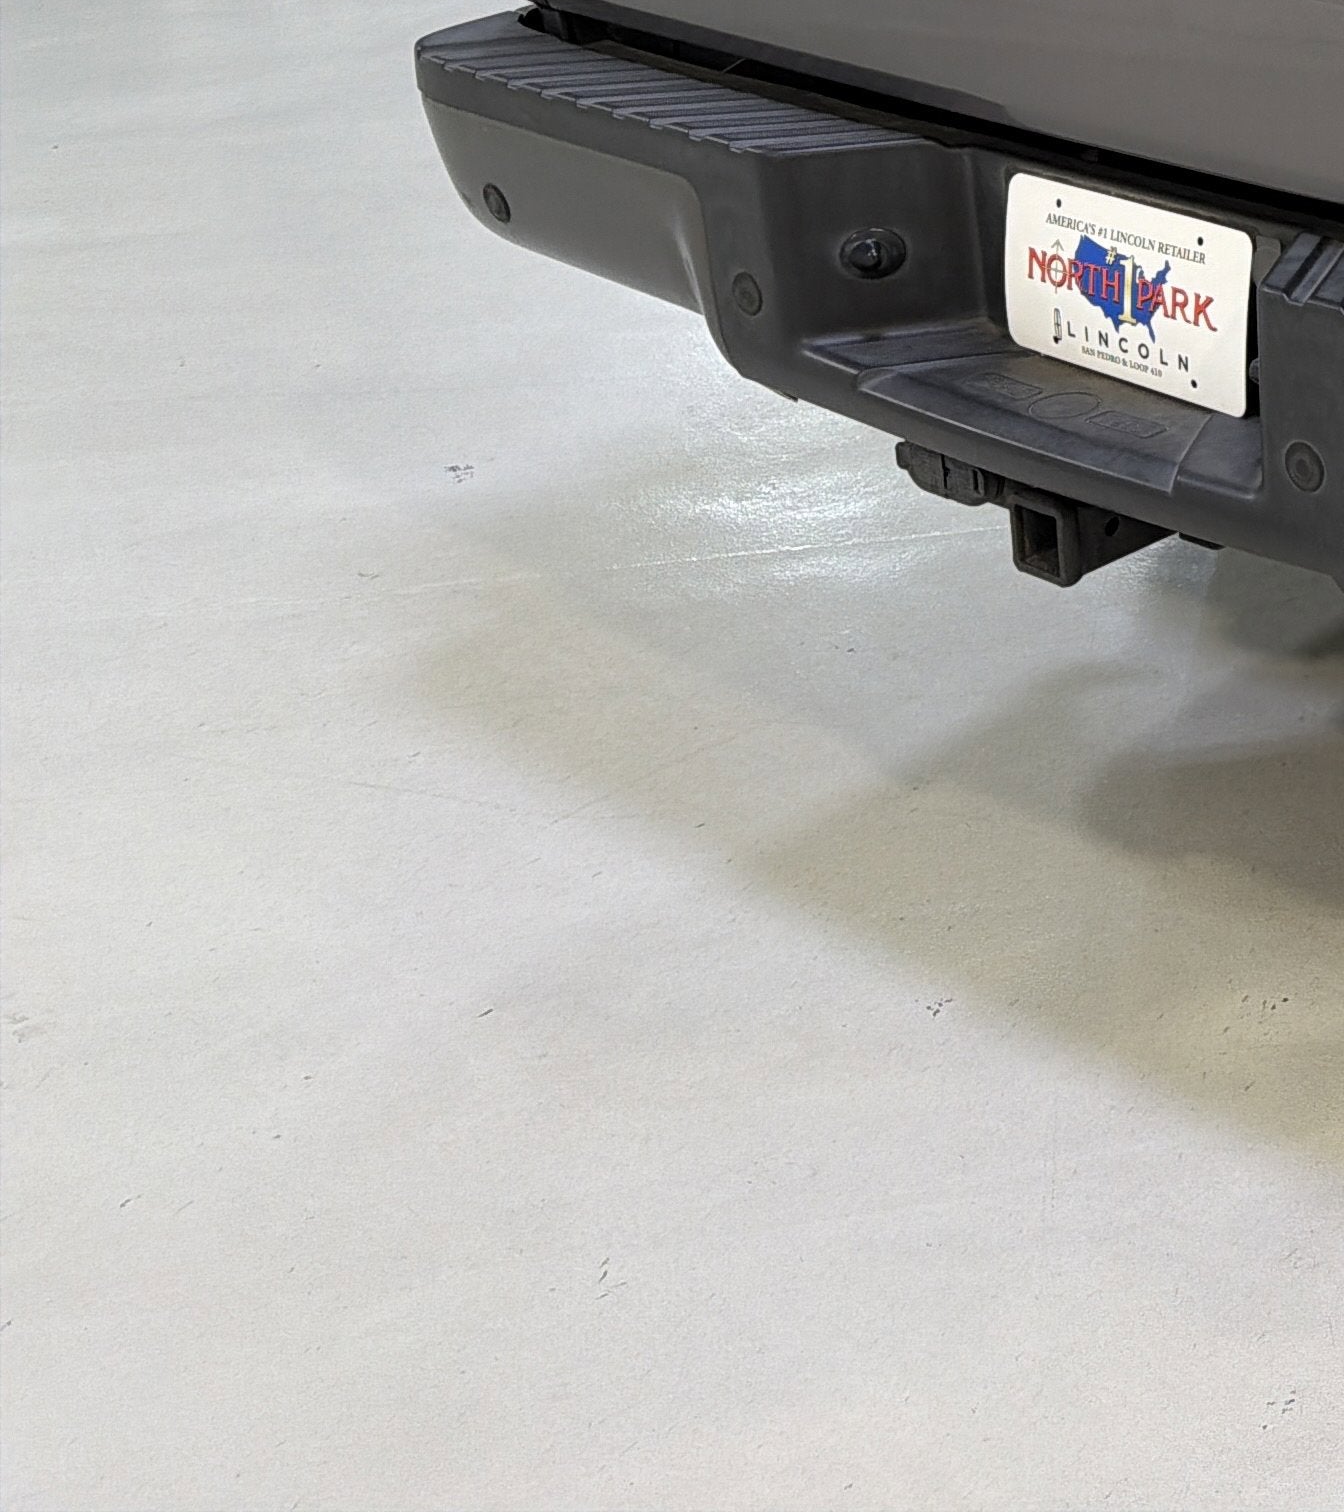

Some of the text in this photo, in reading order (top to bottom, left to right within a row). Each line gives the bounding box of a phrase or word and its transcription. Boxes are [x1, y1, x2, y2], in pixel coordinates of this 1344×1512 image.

[1045, 213, 1206, 264] AMERICA'S #1 LINCOLN RETAILER
[1028, 247, 1218, 332] NORTH PARK
[1067, 320, 1189, 373] LINCOLN
[1096, 349, 1120, 364] PEDRO
[1129, 360, 1149, 373] LOOP
